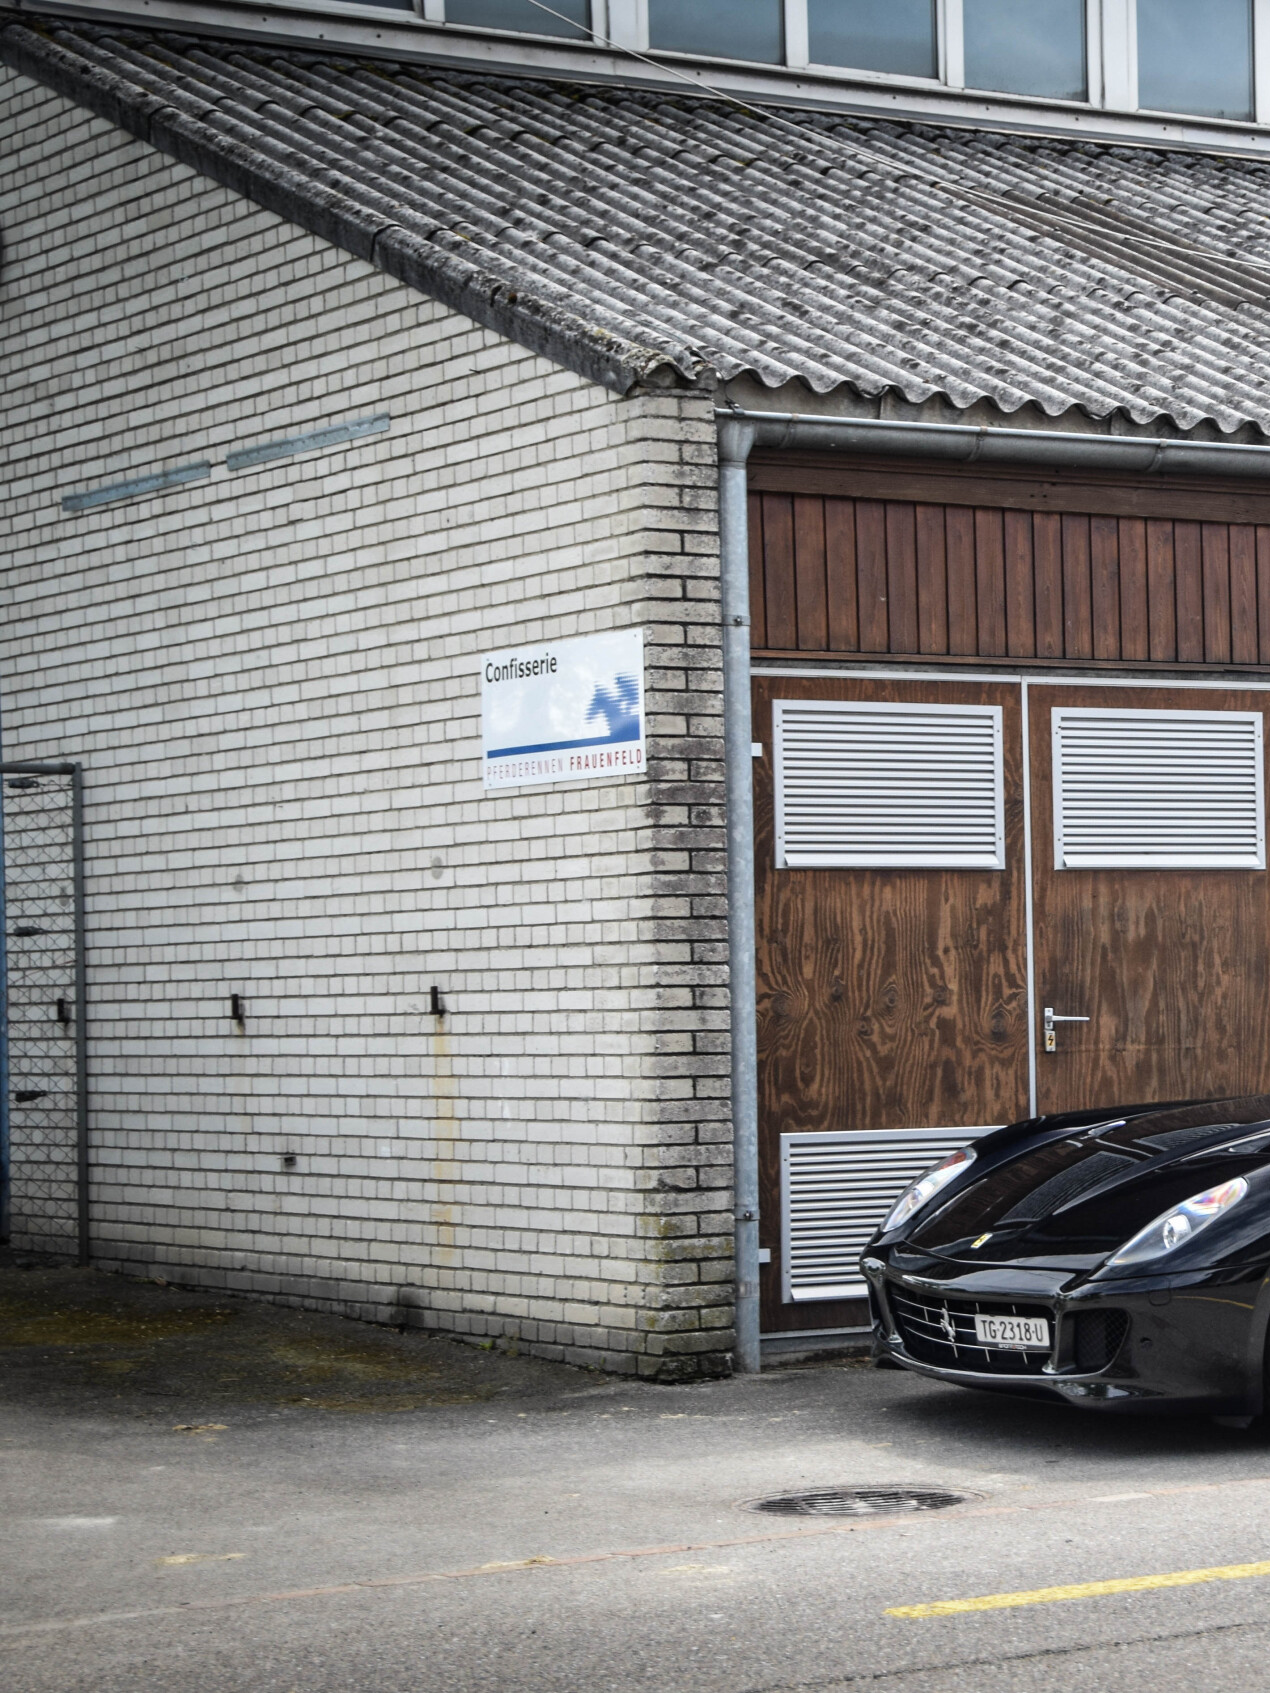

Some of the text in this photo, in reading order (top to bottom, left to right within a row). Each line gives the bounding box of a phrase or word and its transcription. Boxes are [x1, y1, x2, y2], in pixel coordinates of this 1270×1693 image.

[485, 652, 558, 683] Confisserie
[487, 749, 642, 780] PFERDERENNEN FRAUENFELD
